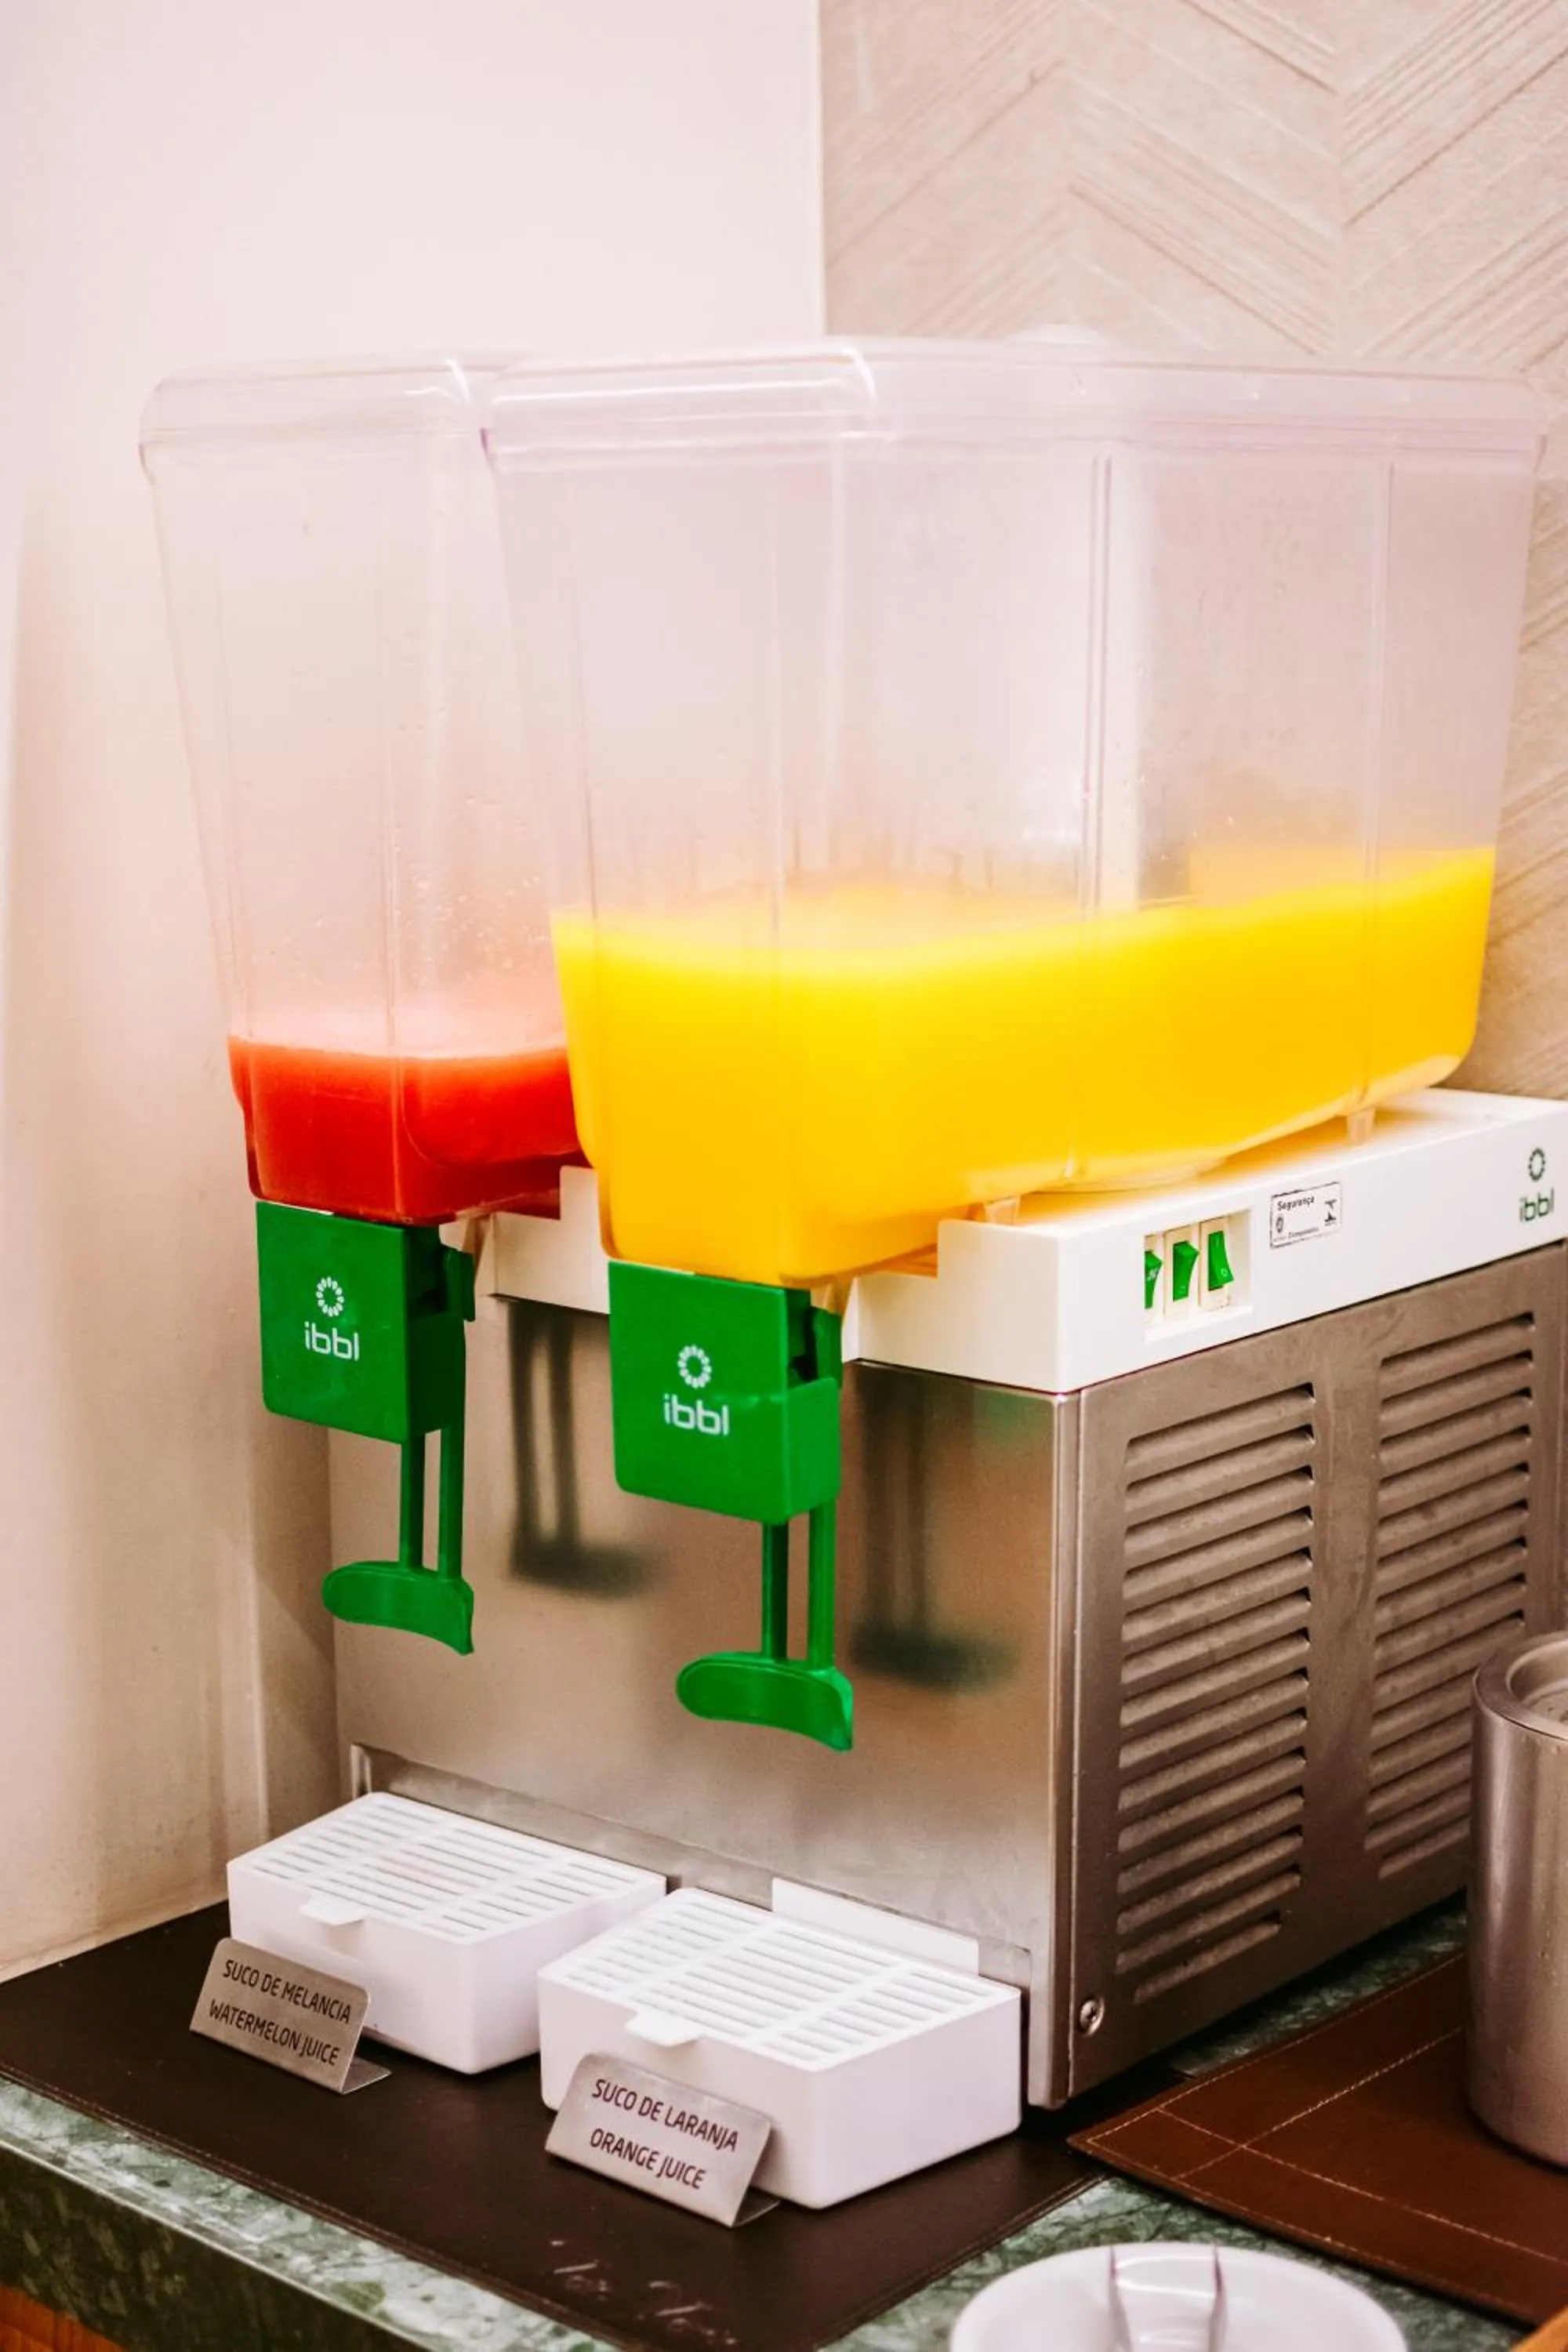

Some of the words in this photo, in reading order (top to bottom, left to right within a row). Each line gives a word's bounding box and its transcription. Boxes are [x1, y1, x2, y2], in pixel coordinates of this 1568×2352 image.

[1519, 1187, 1554, 1222] ibbl
[304, 1321, 359, 1361] ibbl
[663, 1393, 729, 1436] ibbl
[223, 1960, 260, 1987] SUCO
[262, 1974, 281, 1997] DE
[282, 1981, 351, 2024] MELANCIA
[209, 1999, 302, 2051] WATERMELON
[300, 2038, 340, 2065] JUICE
[592, 2079, 637, 2111] SUCO
[639, 2096, 663, 2121] DE
[665, 2107, 739, 2151] LARANJA
[590, 2129, 659, 2170] ORANGE
[657, 2156, 706, 2189] JUICE
